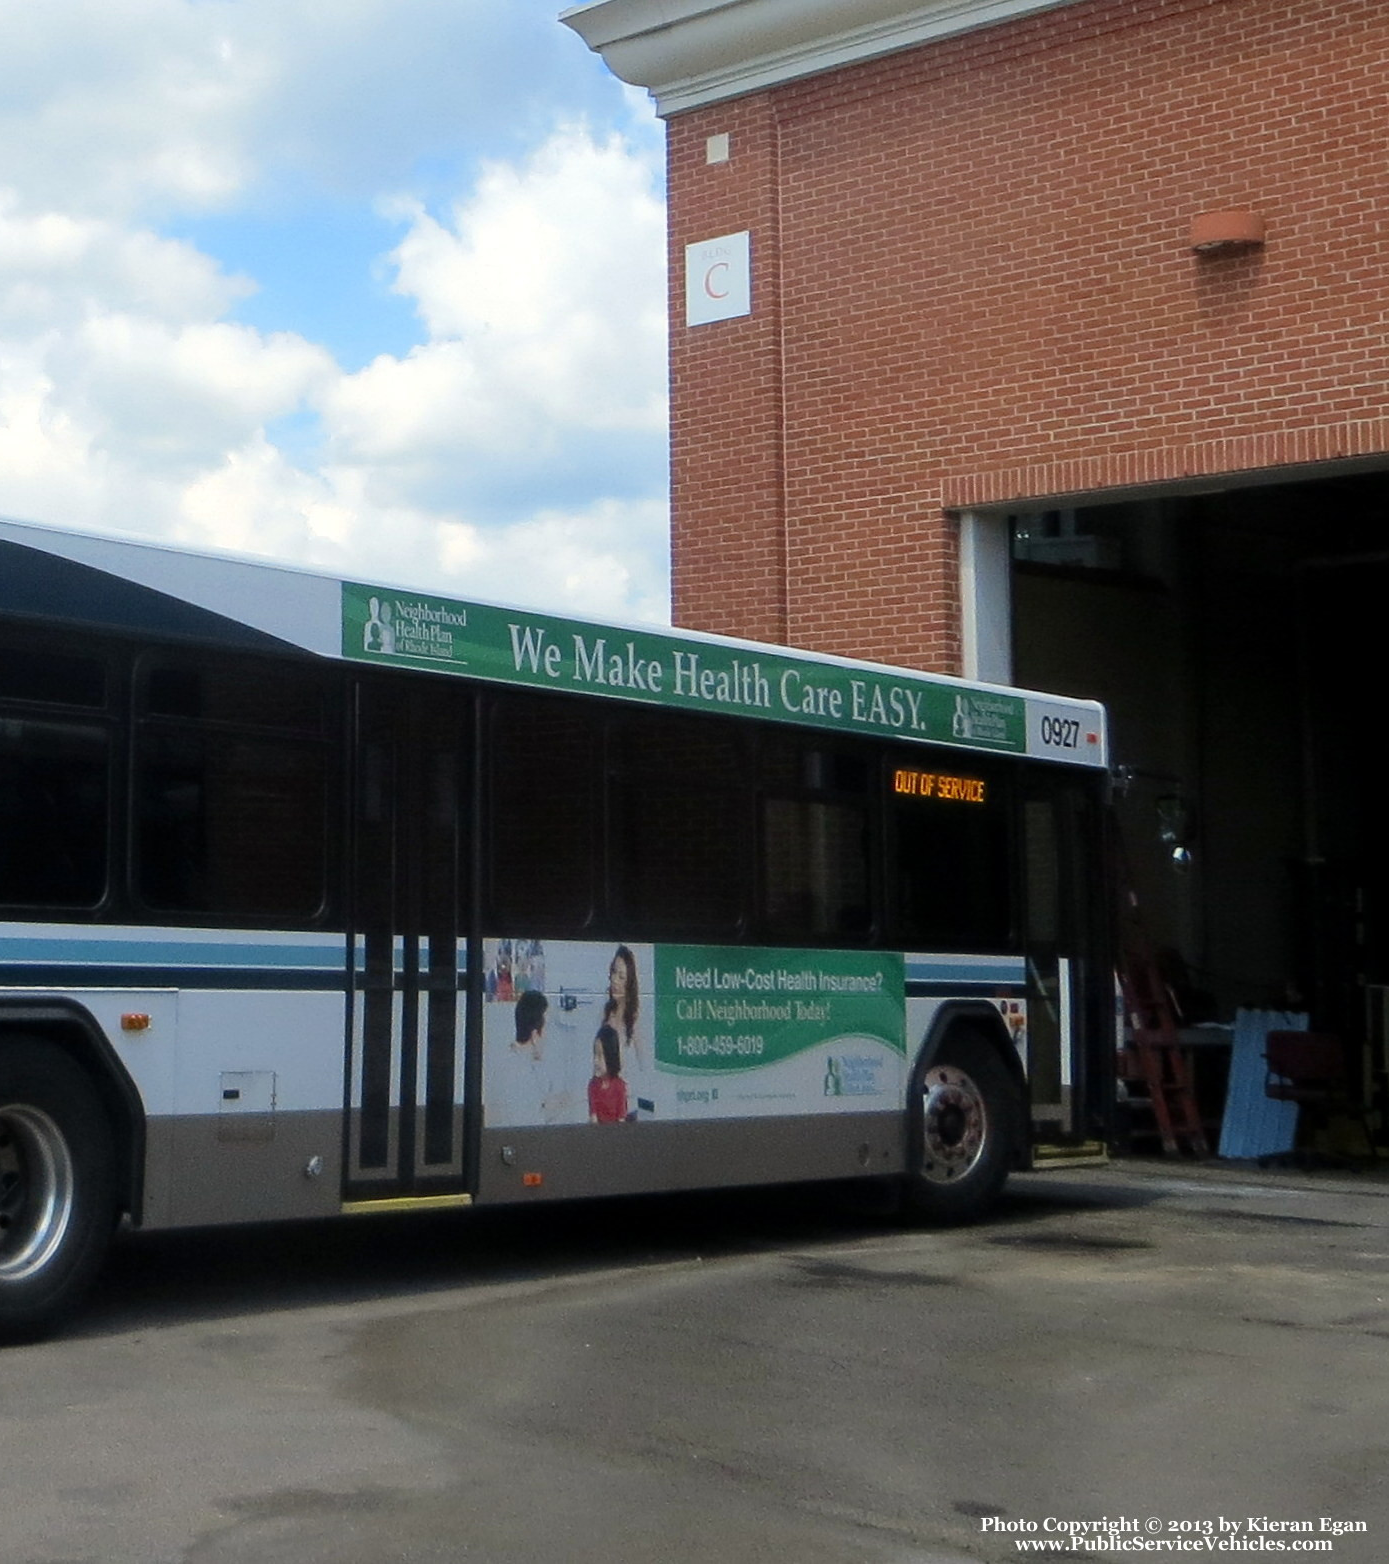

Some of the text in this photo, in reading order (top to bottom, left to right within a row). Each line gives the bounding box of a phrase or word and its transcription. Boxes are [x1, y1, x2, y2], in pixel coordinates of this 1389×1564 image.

[704, 262, 730, 300] C
[394, 600, 467, 627] Neighborhood
[395, 620, 453, 644] Health Plan
[508, 623, 562, 678] We
[572, 634, 663, 693] Make
[673, 650, 771, 709] Health
[780, 669, 842, 719] Care
[850, 680, 927, 731] EASY.
[1041, 715, 1080, 749] 0927
[895, 769, 985, 803] OUT OF SERVICE
[676, 967, 884, 993] Need Low-Cost Health Insurance?
[676, 999, 831, 1027] Call Neighborhood Today!
